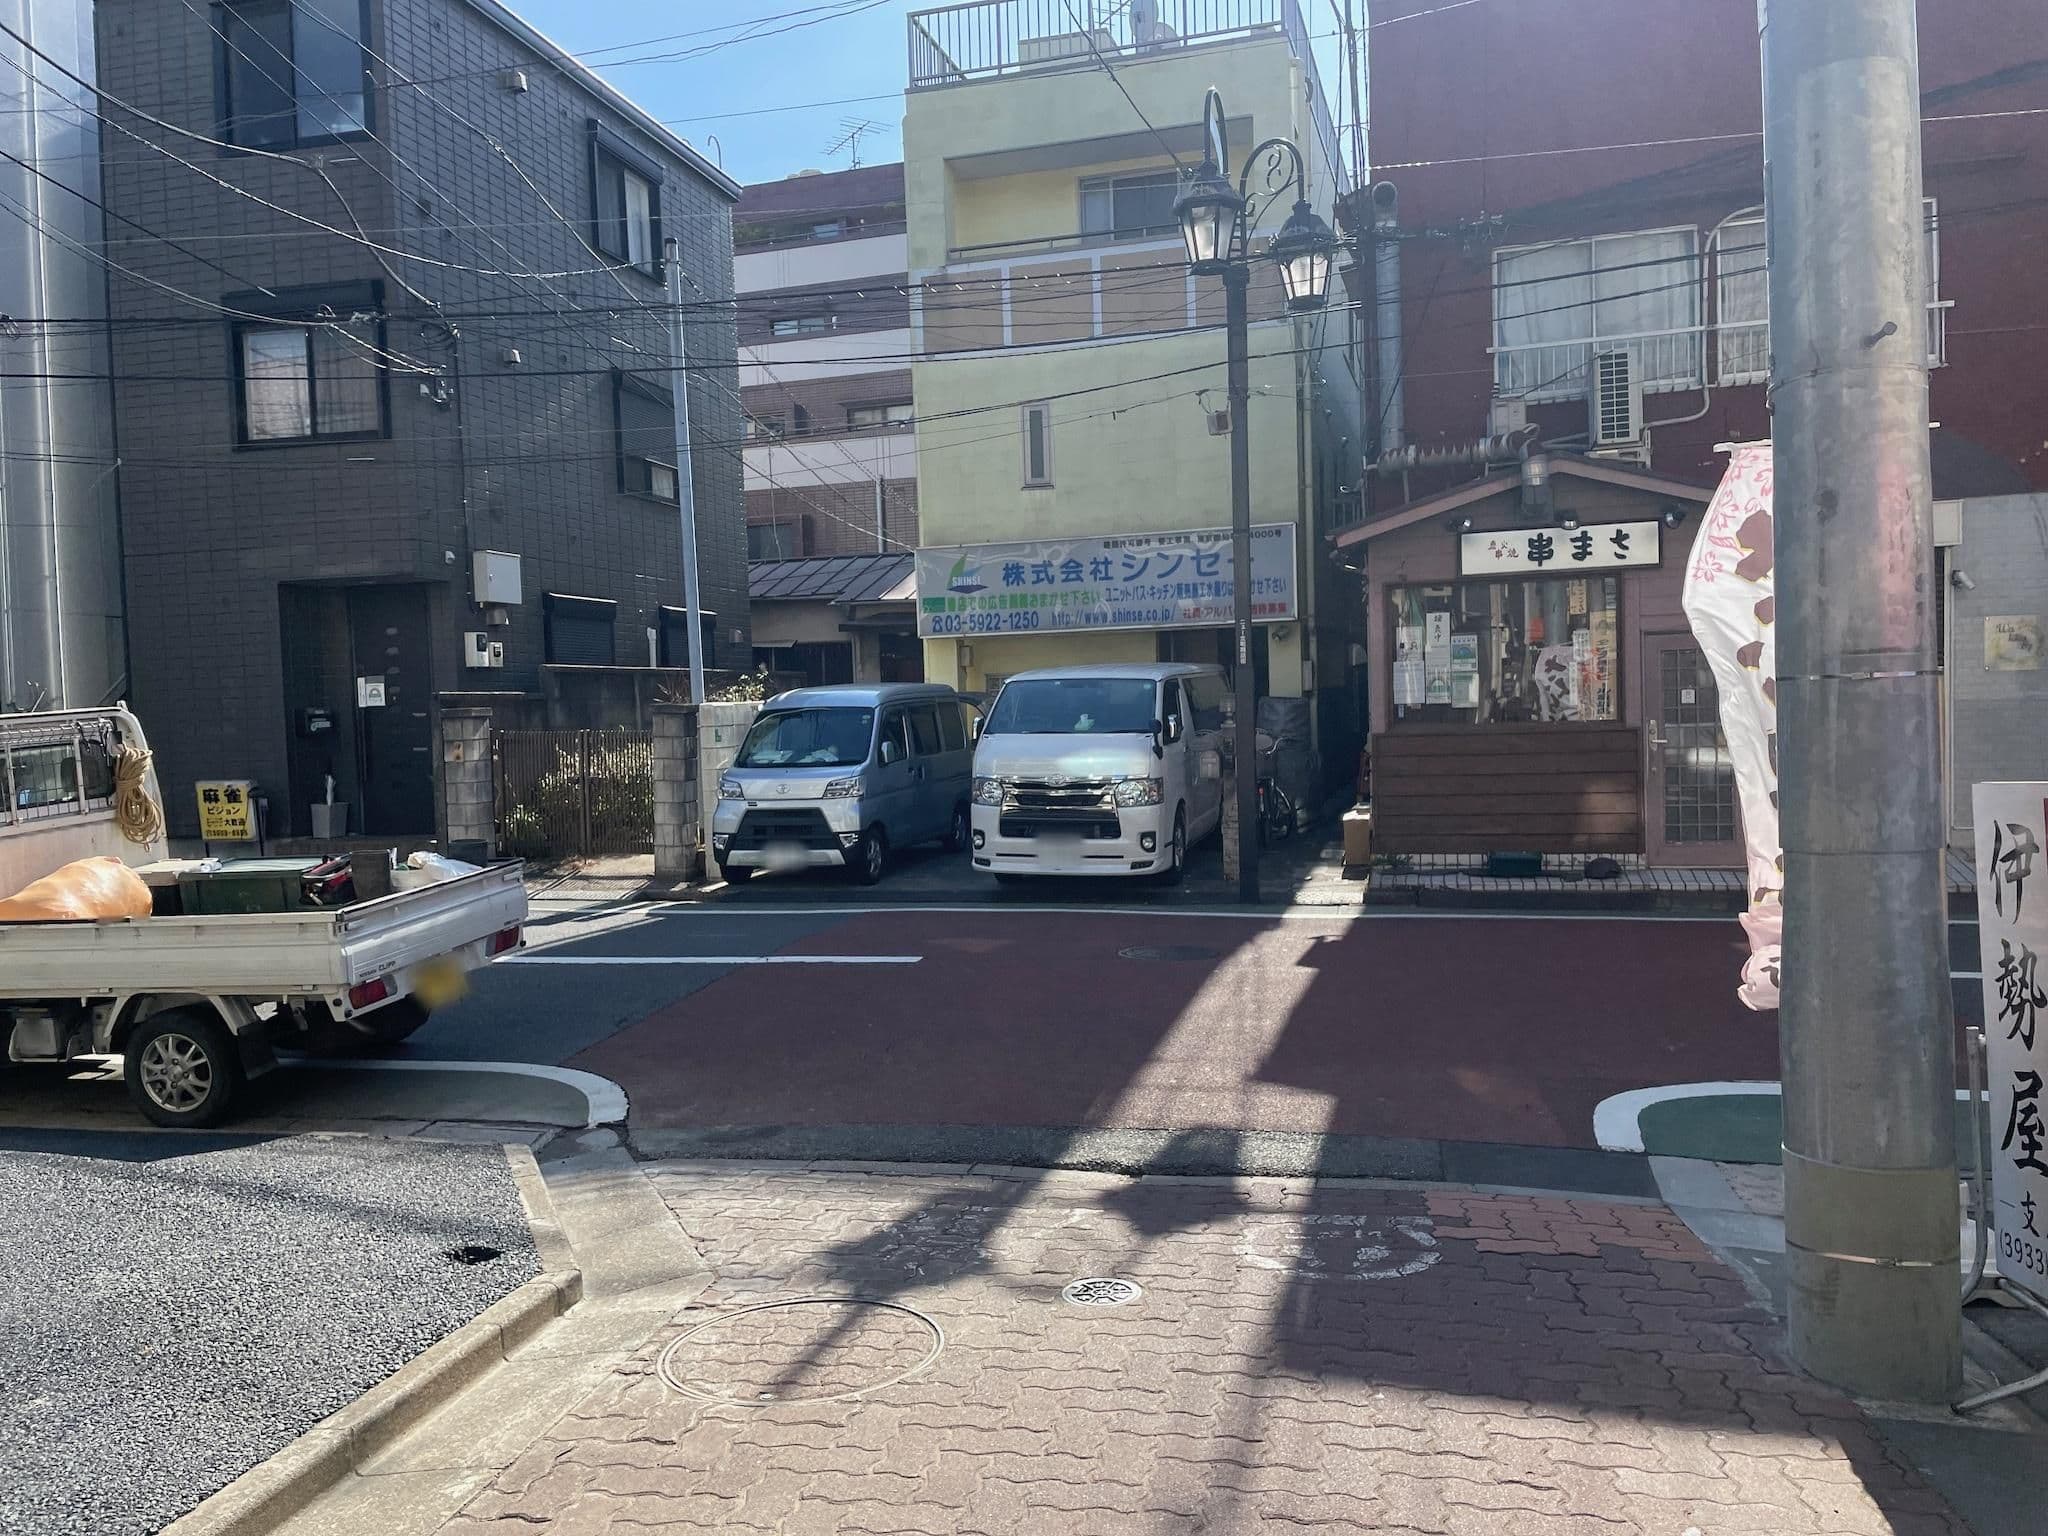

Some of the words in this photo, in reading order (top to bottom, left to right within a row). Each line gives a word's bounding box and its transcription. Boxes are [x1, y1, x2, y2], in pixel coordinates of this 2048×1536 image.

[1527, 528, 1631, 567] 串まさ
[945, 610, 1039, 632] 03-5922-1250
[1052, 604, 1177, 626] http://www.shinse.co.jp/
[202, 785, 243, 804] 麻雀
[1989, 818, 2048, 1181] 伊勢屋
